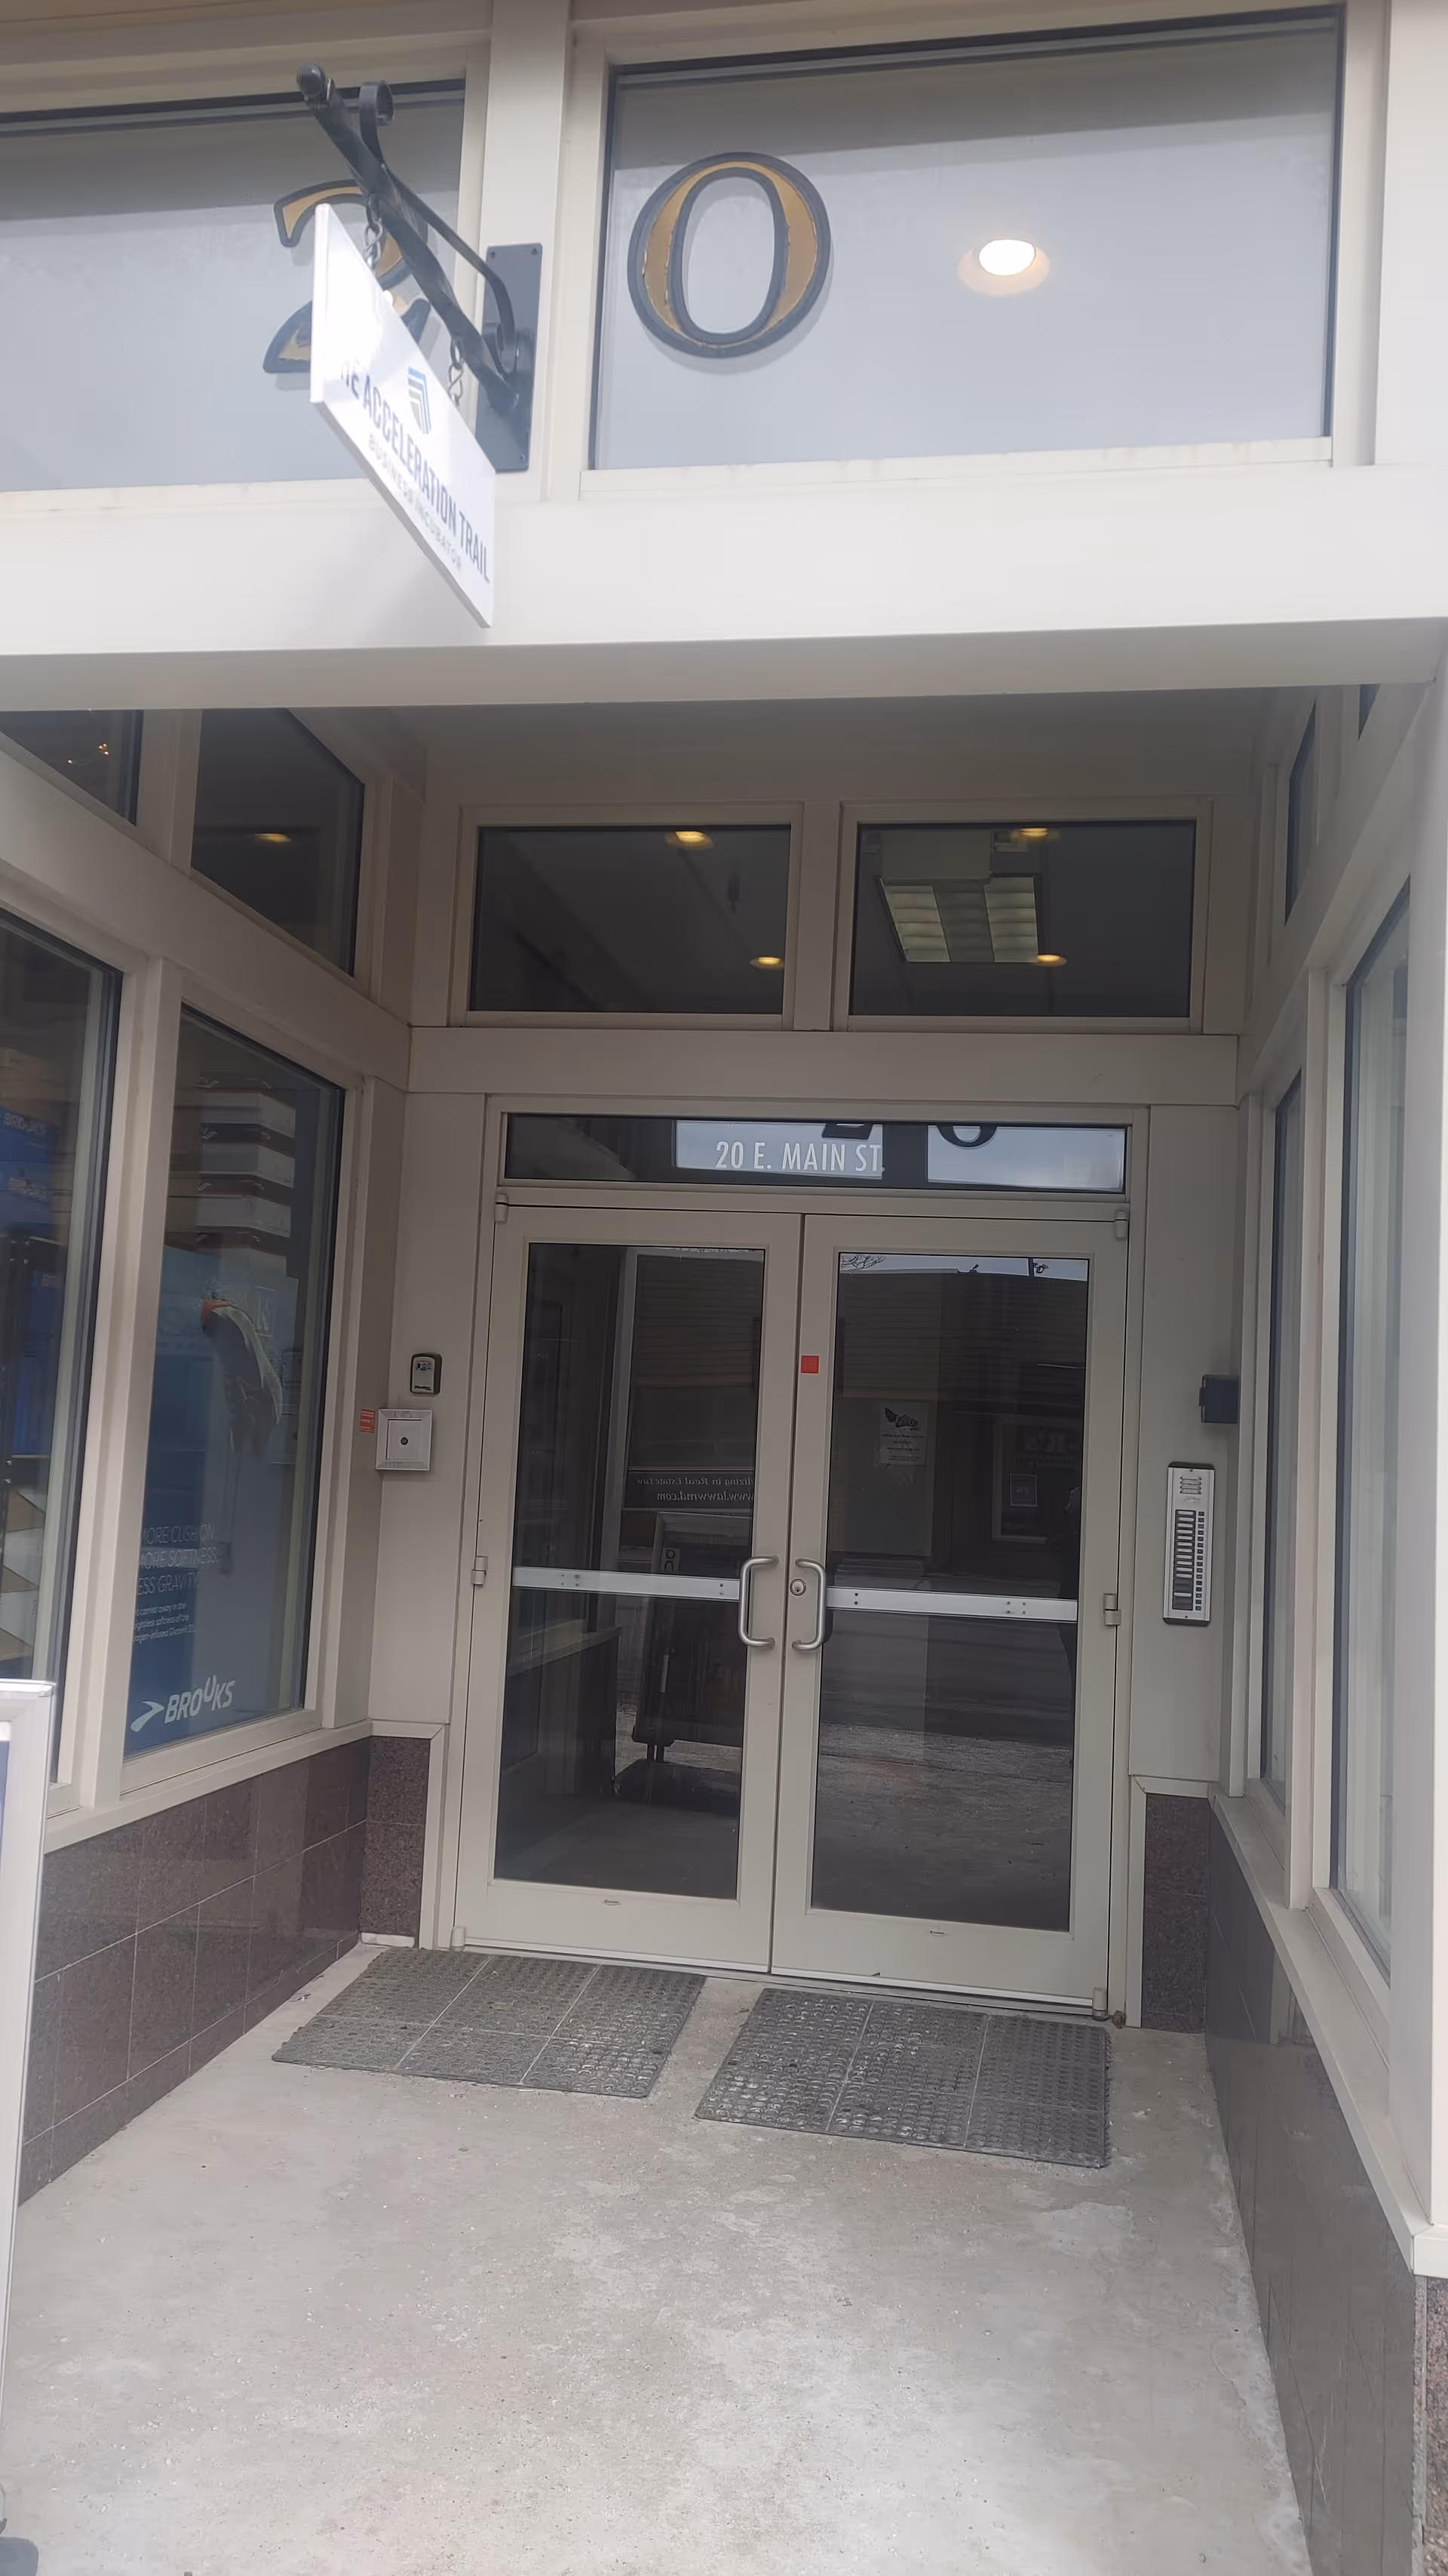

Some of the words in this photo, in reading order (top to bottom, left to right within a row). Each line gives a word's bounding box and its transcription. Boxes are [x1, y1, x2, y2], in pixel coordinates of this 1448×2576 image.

[363, 374, 457, 537] ACCELERATION
[459, 509, 490, 585] TRAIL
[368, 430, 413, 505] BUSINESS
[714, 1141, 744, 1169] 20
[753, 1141, 772, 1170] E.
[781, 1142, 846, 1172] MAIN
[854, 1144, 885, 1173] ST.
[138, 1577, 155, 1595] ESS
